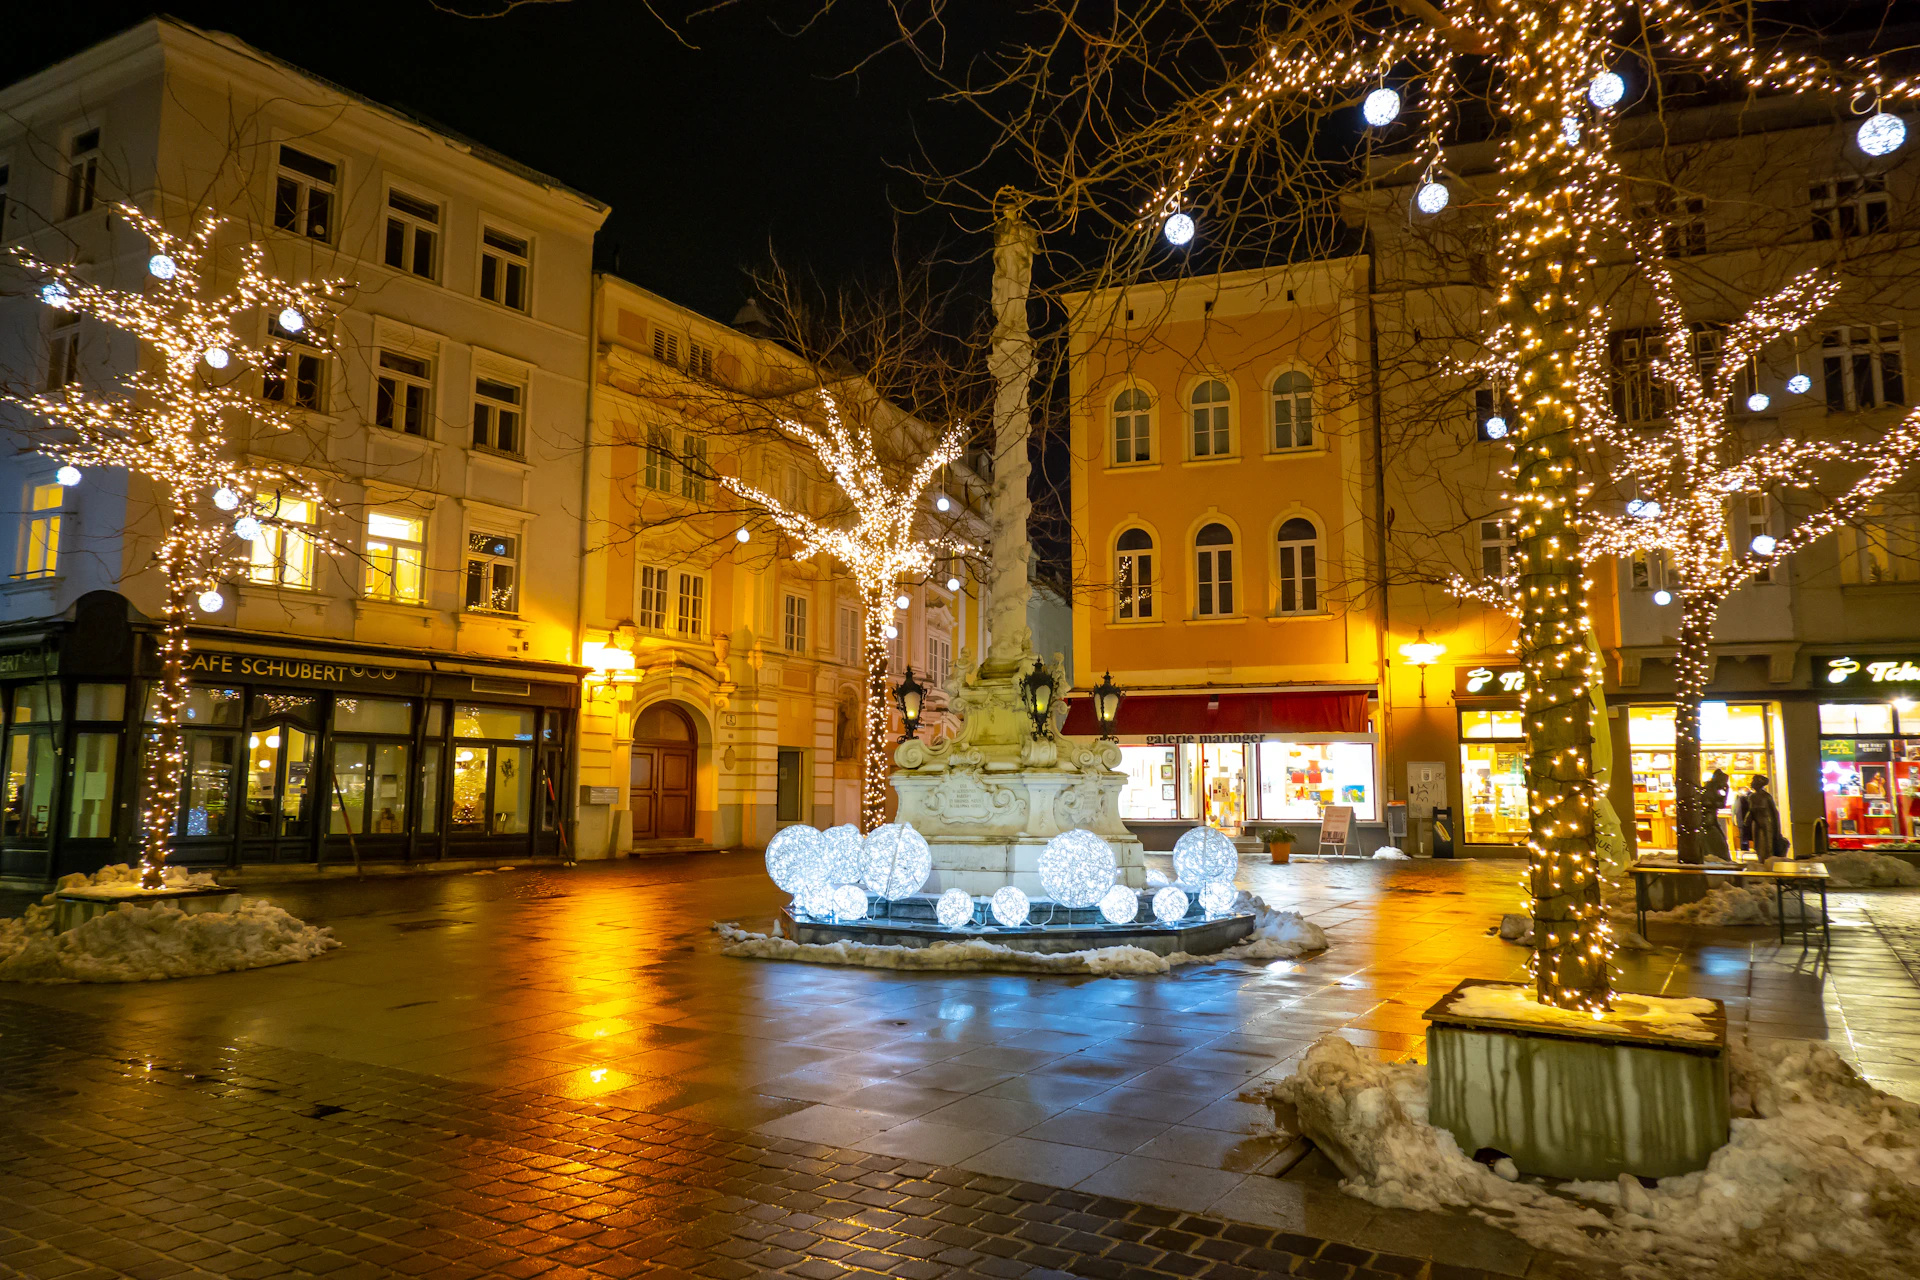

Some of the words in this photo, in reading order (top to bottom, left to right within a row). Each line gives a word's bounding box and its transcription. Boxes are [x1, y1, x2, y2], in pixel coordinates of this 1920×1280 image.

[241, 657, 349, 682] SCHUBERT
[1146, 733, 1195, 747] galerie
[1200, 732, 1266, 746] maringer
